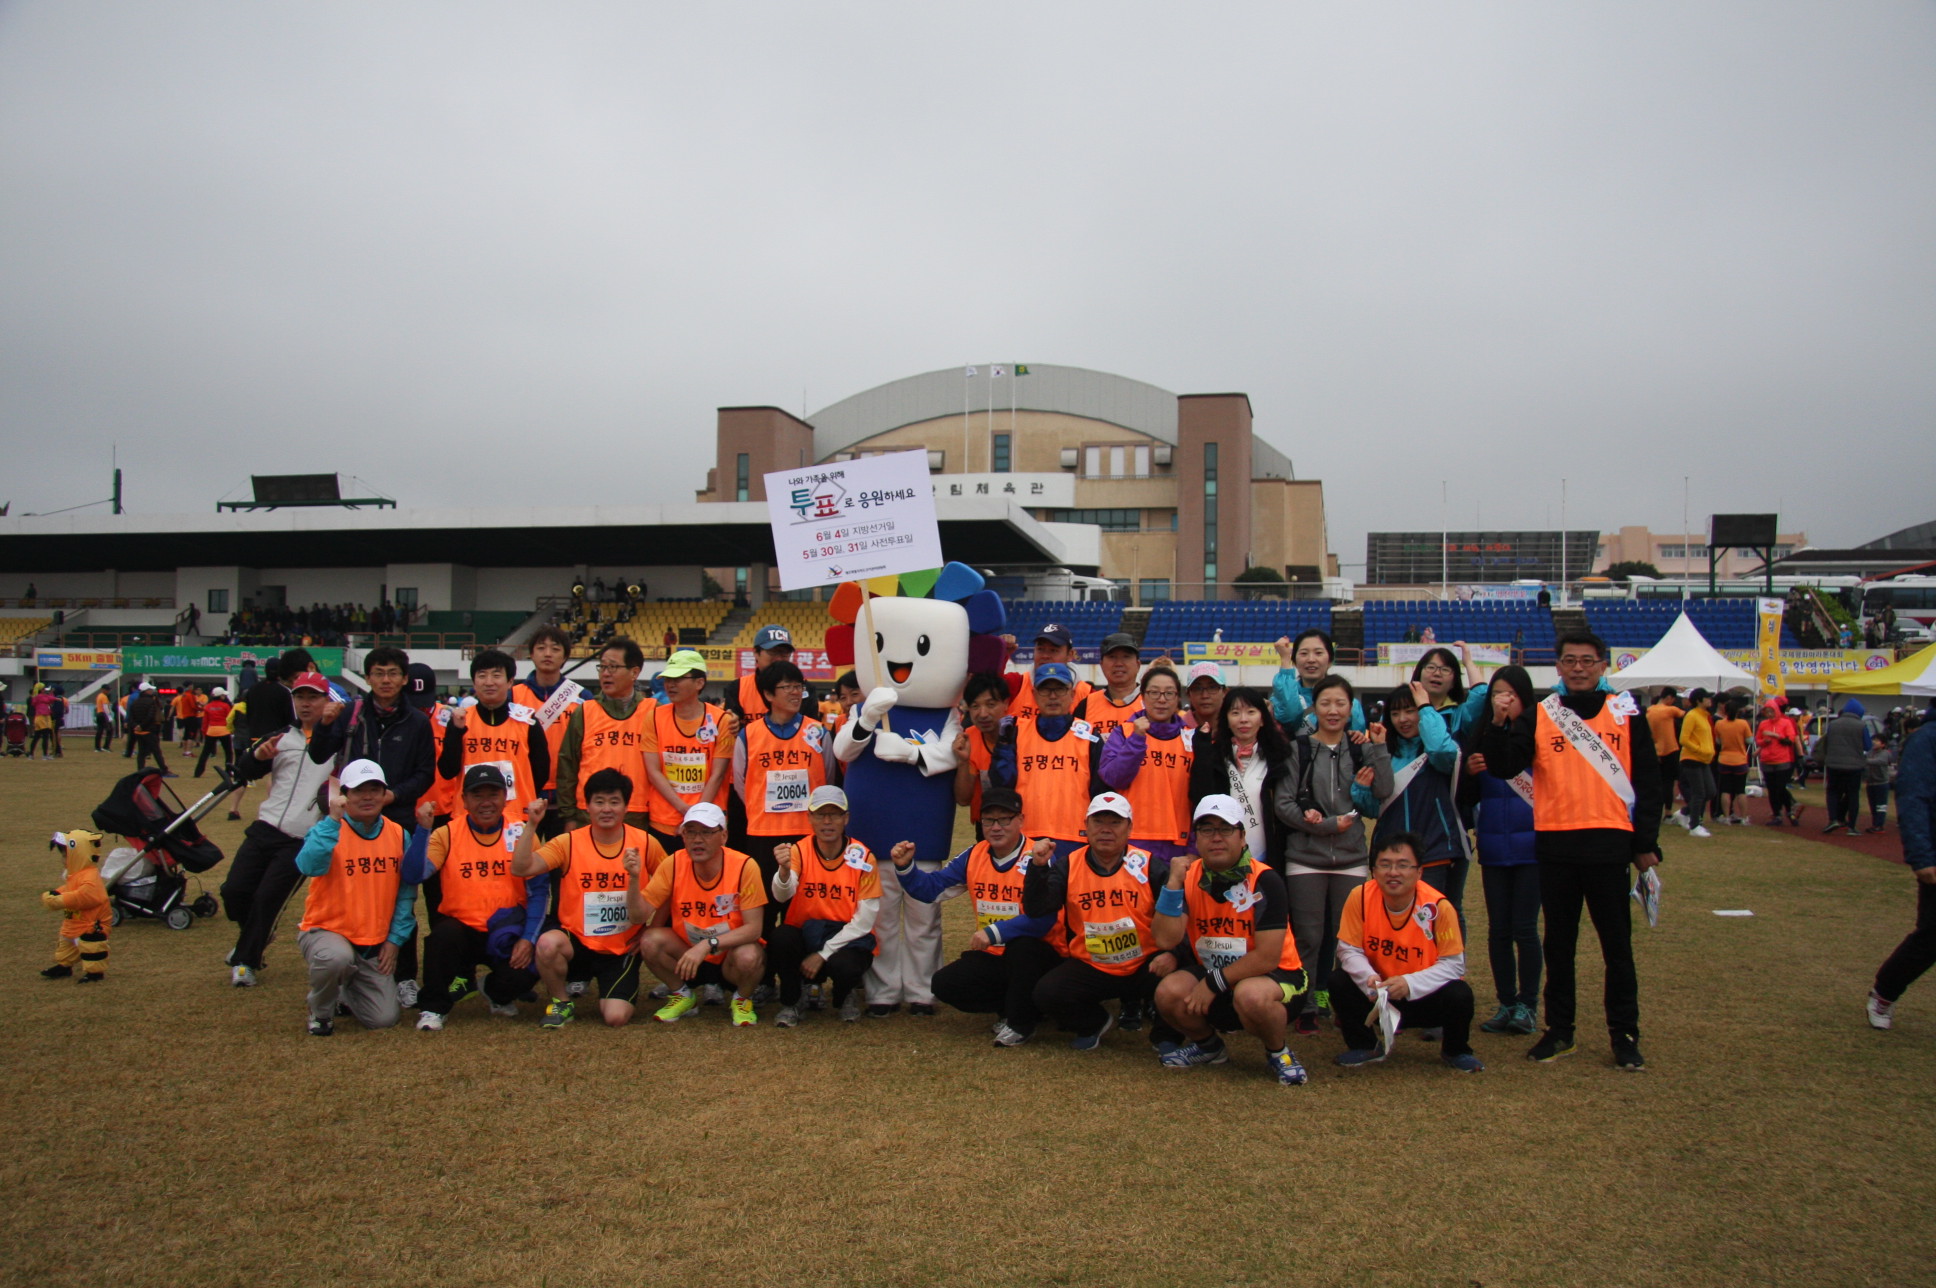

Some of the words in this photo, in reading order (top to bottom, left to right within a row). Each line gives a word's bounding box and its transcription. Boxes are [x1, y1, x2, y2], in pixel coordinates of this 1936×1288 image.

[789, 476, 804, 486] 나와
[830, 471, 845, 480] 위해
[858, 488, 916, 509] 응원하세요
[933, 482, 1044, 496] 림체육관
[816, 530, 832, 542] 6월
[834, 527, 850, 539] 4일
[852, 521, 896, 536] 지방선거일
[802, 548, 818, 559] 5월
[848, 541, 868, 553] 31일
[871, 534, 913, 549] 사전투표일
[1214, 645, 1264, 657] 화장실
[415, 678, 424, 691] D
[467, 737, 519, 756] 공명선거
[759, 750, 812, 768] 공명선거
[1022, 754, 1079, 773] 공명선거
[676, 768, 703, 782] 11031
[777, 784, 807, 800] 20604
[345, 857, 399, 876] 공명선거
[460, 859, 512, 879] 공명선
[580, 872, 630, 889] 공명선
[804, 882, 856, 902] 공명선거
[1078, 889, 1138, 911] 공명선거
[600, 906, 630, 922] 2060
[680, 901, 731, 919] 공명선
[1196, 917, 1252, 936] 공명선거
[1102, 933, 1137, 953] 11020
[1367, 935, 1424, 965] 공명선거
[1211, 954, 1243, 968] 206
